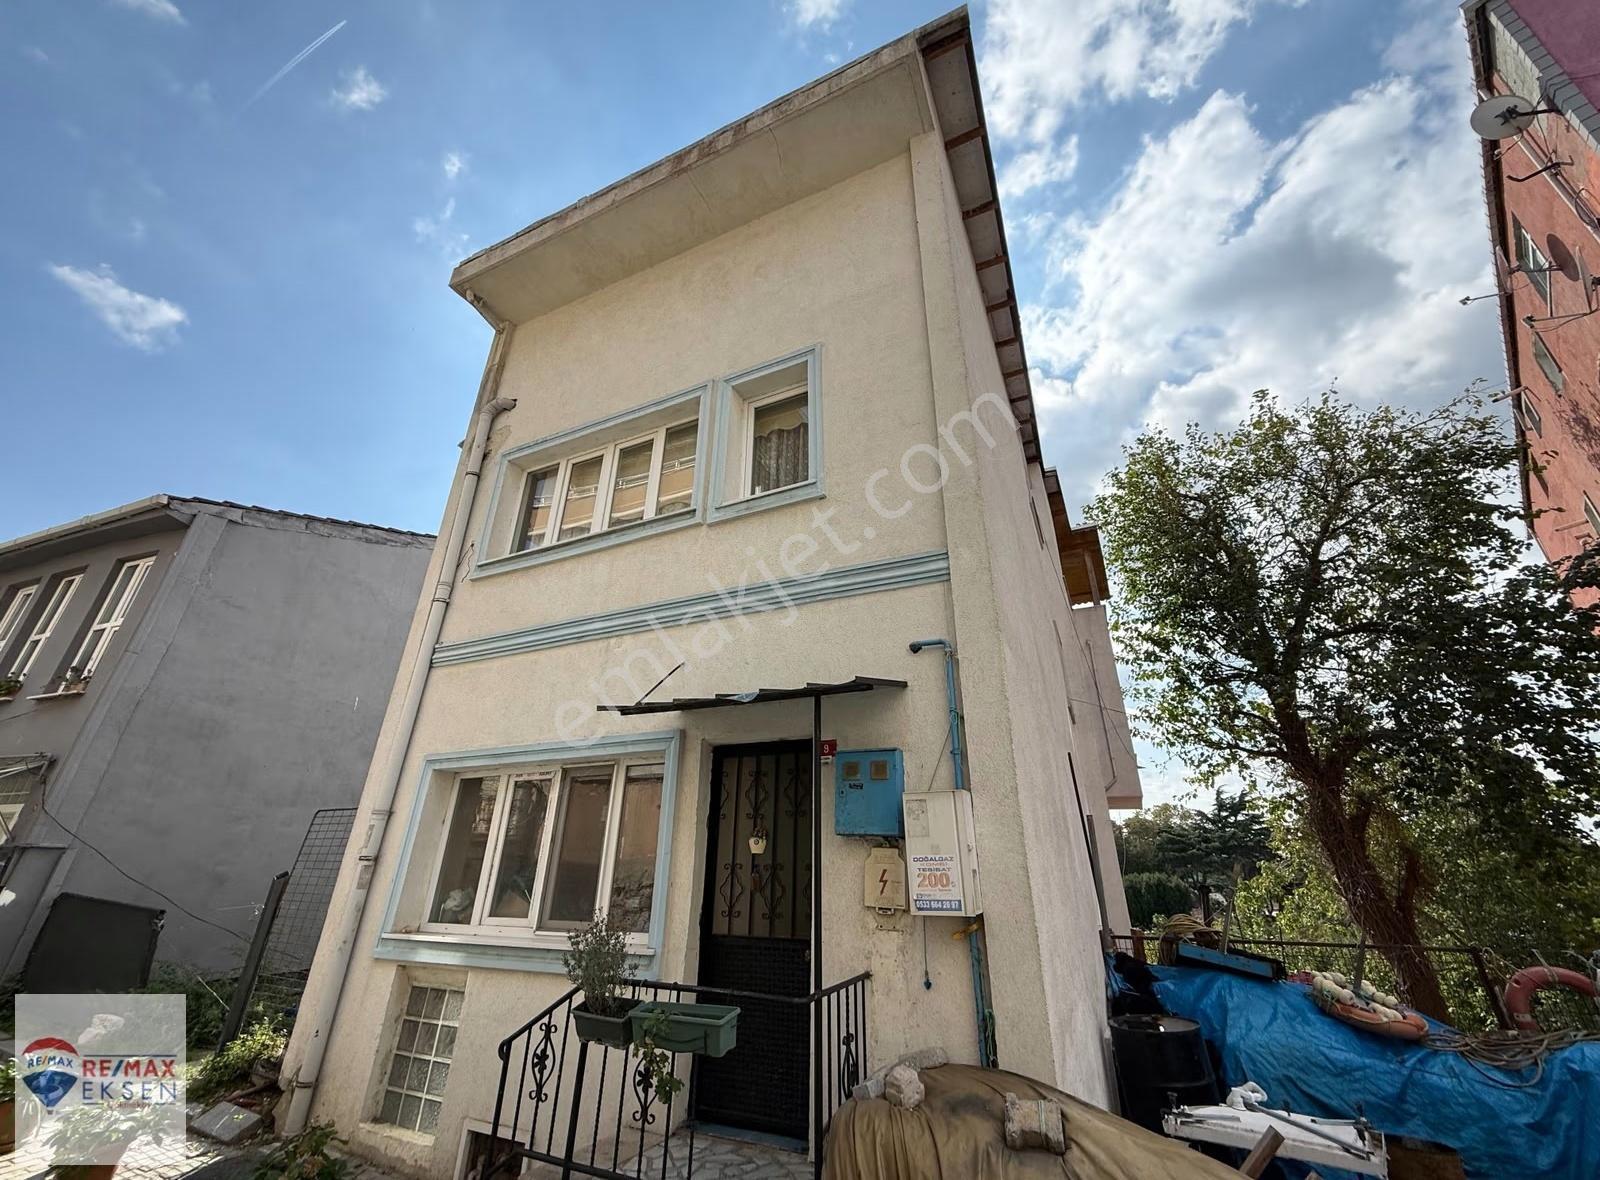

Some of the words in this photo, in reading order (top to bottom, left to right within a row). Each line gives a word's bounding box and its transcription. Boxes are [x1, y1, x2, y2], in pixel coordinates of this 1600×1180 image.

[823, 744, 830, 753] 9
[917, 872, 951, 889] 200
[916, 900, 930, 908] 0533
